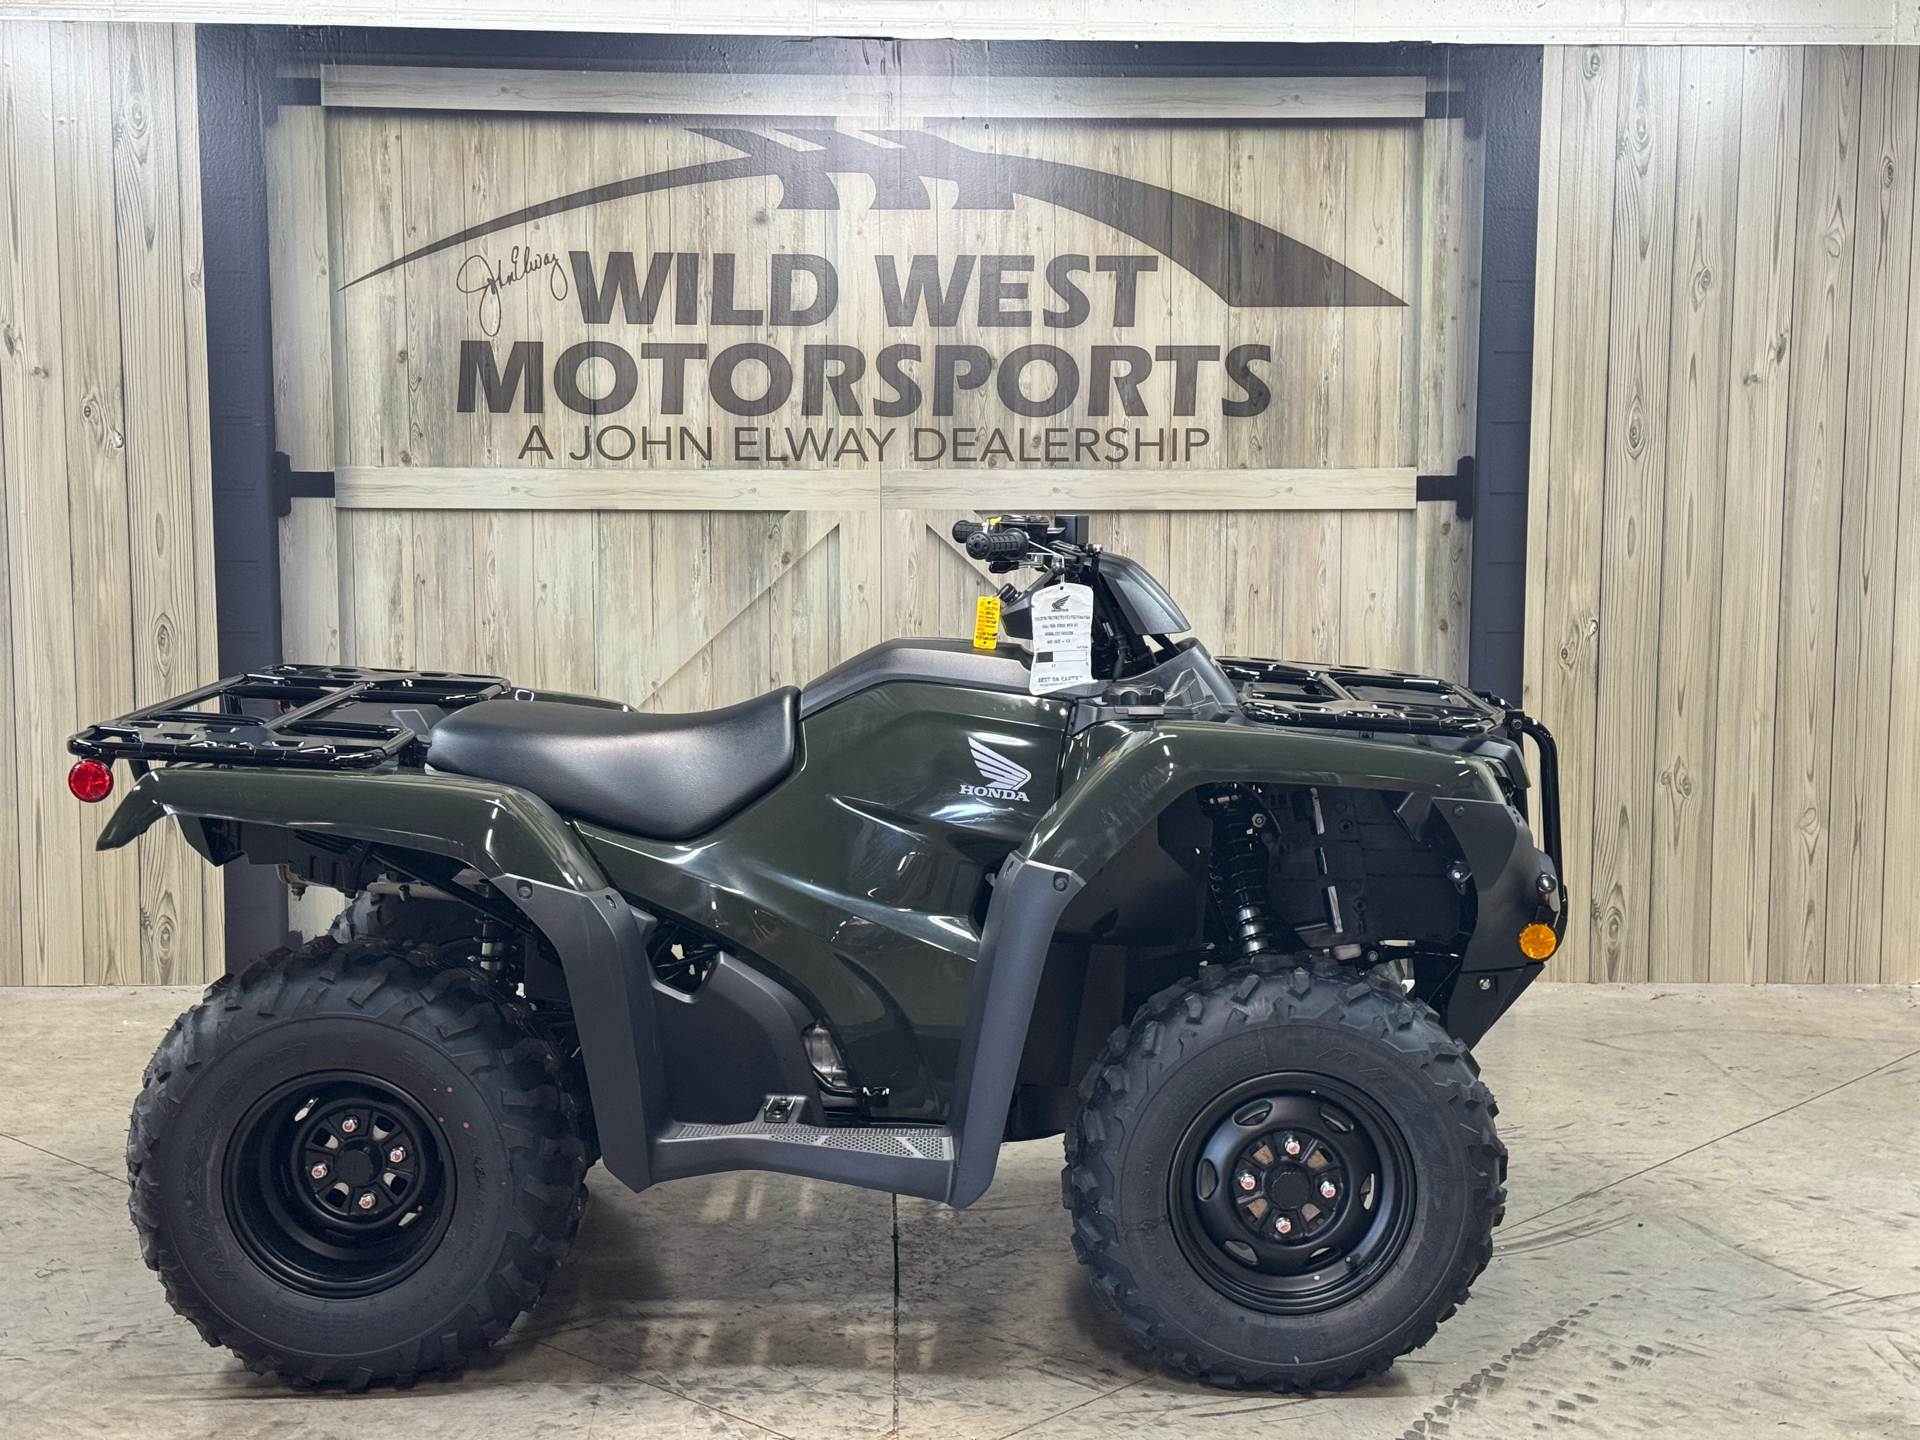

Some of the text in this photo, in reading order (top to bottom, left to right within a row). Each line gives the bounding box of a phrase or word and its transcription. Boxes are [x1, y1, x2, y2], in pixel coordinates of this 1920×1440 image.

[568, 250, 1159, 328] WILD WEST
[456, 340, 1272, 418] MOTORSPORTS
[517, 425, 1211, 463] A JOHN ELWAY DEALERSHIP
[959, 784, 1031, 803] HONDA
